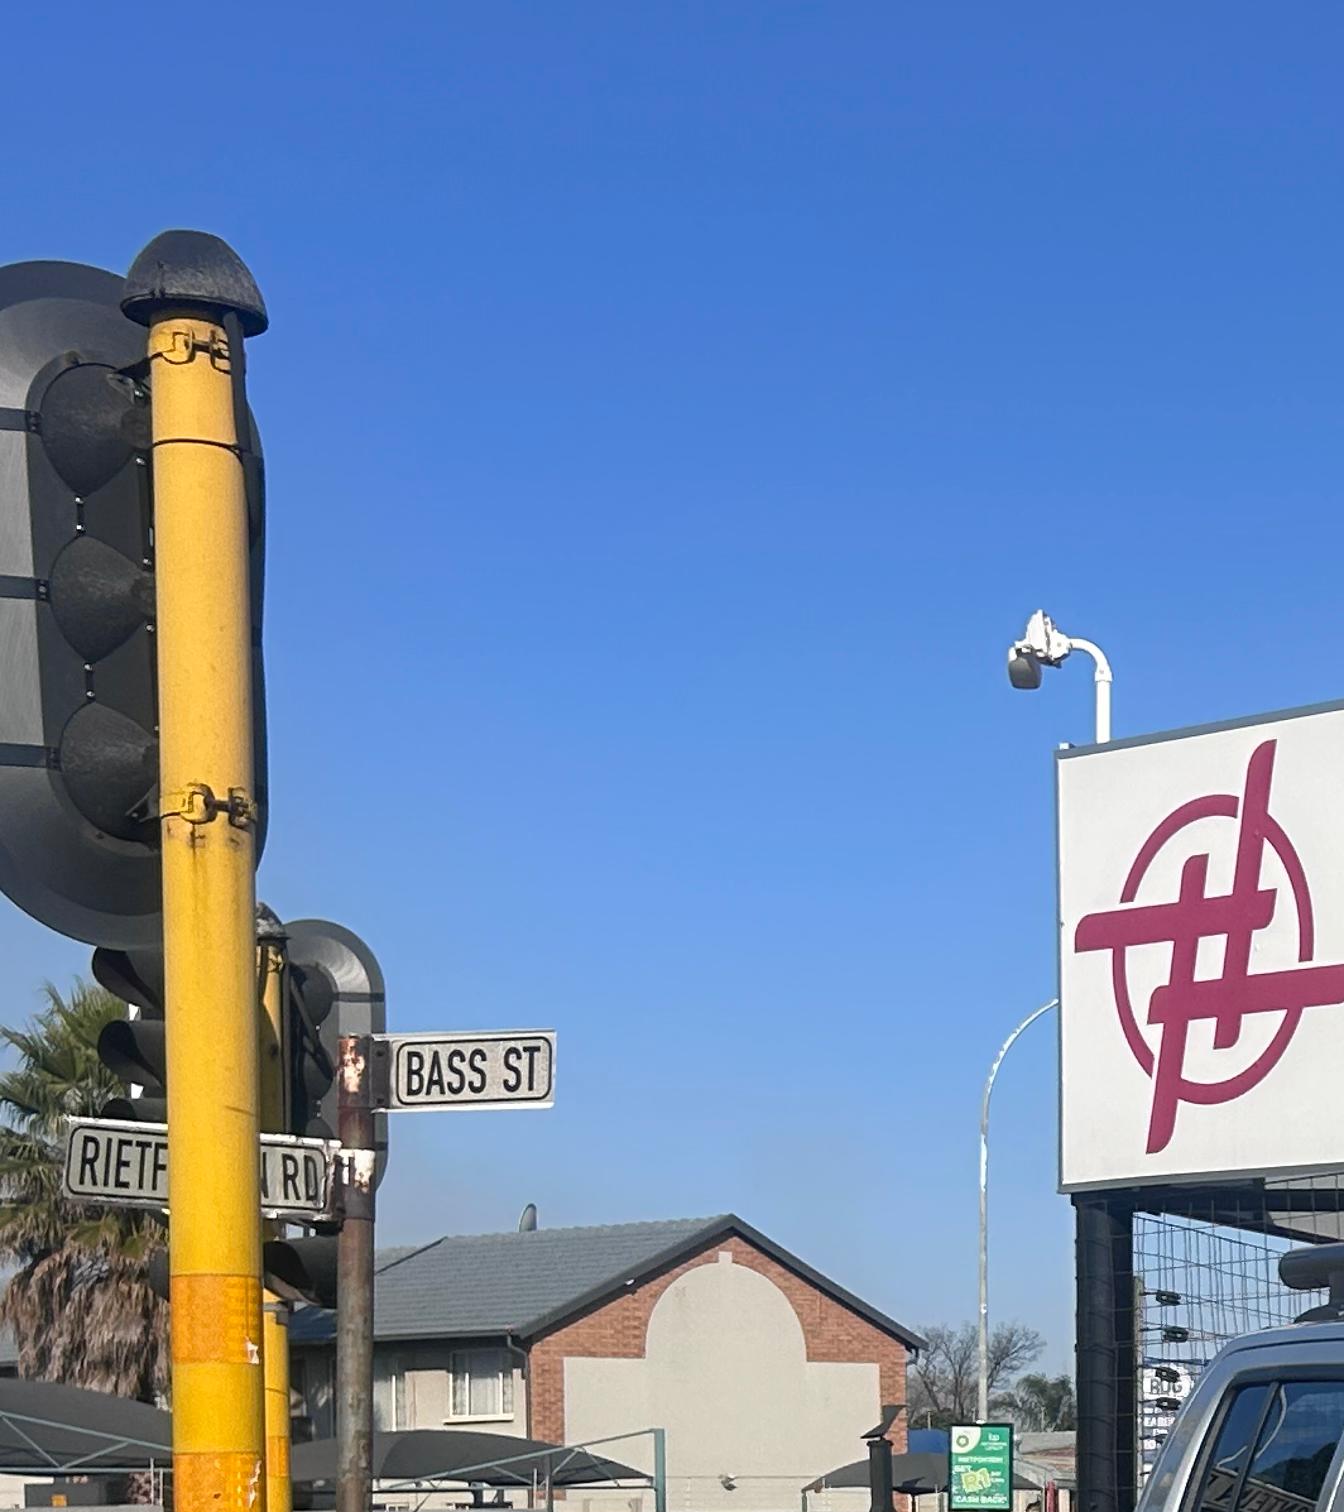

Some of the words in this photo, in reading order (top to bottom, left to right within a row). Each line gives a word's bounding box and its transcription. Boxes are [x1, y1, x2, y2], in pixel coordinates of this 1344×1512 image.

[407, 1048, 487, 1096] BASS
[503, 1046, 541, 1092] ST
[282, 1154, 319, 1202] RD
